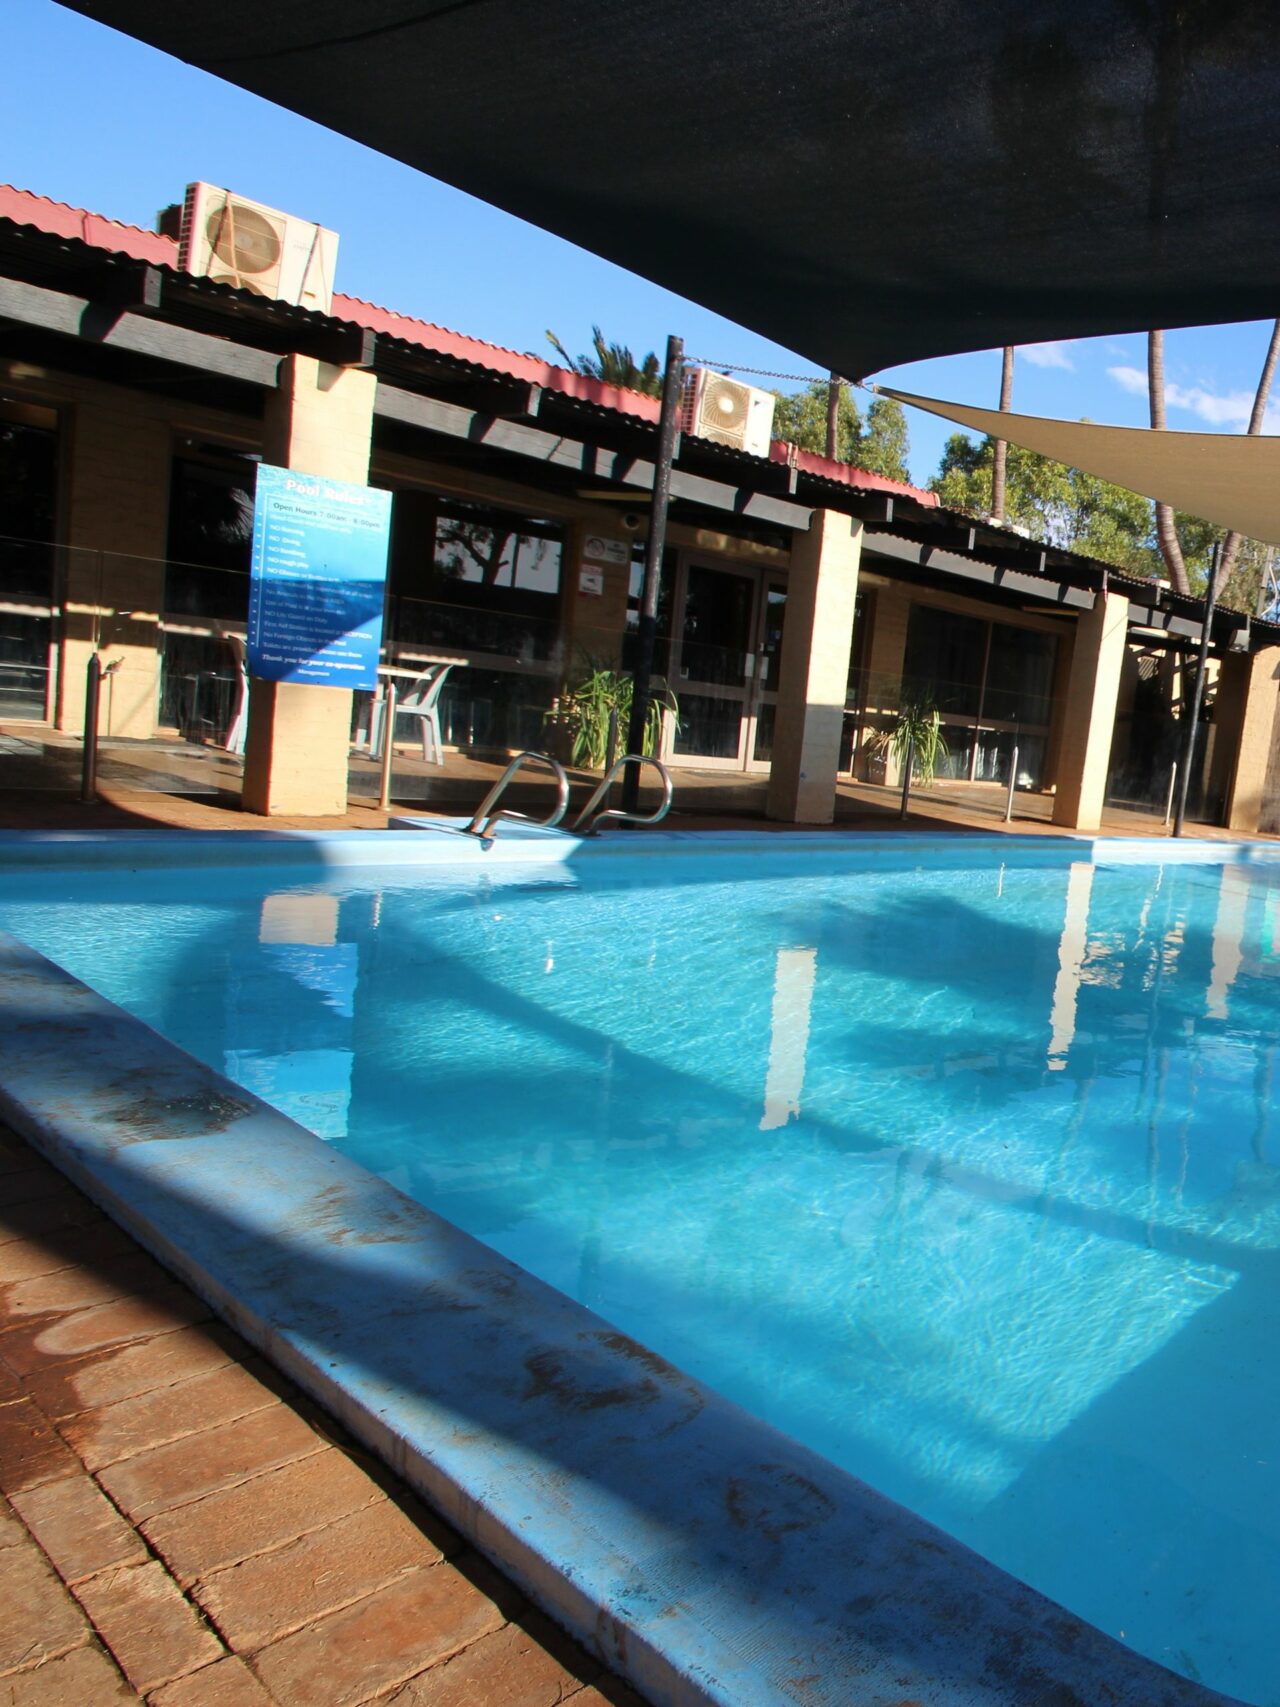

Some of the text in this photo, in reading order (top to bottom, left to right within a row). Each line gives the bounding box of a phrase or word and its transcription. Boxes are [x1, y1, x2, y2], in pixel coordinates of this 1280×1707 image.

[285, 478, 364, 506] Pool Rules
[273, 501, 293, 511] Open
[295, 506, 316, 516] Hours
[268, 545, 279, 553] NO
[267, 556, 278, 564] NO
[262, 653, 282, 662] Thank
